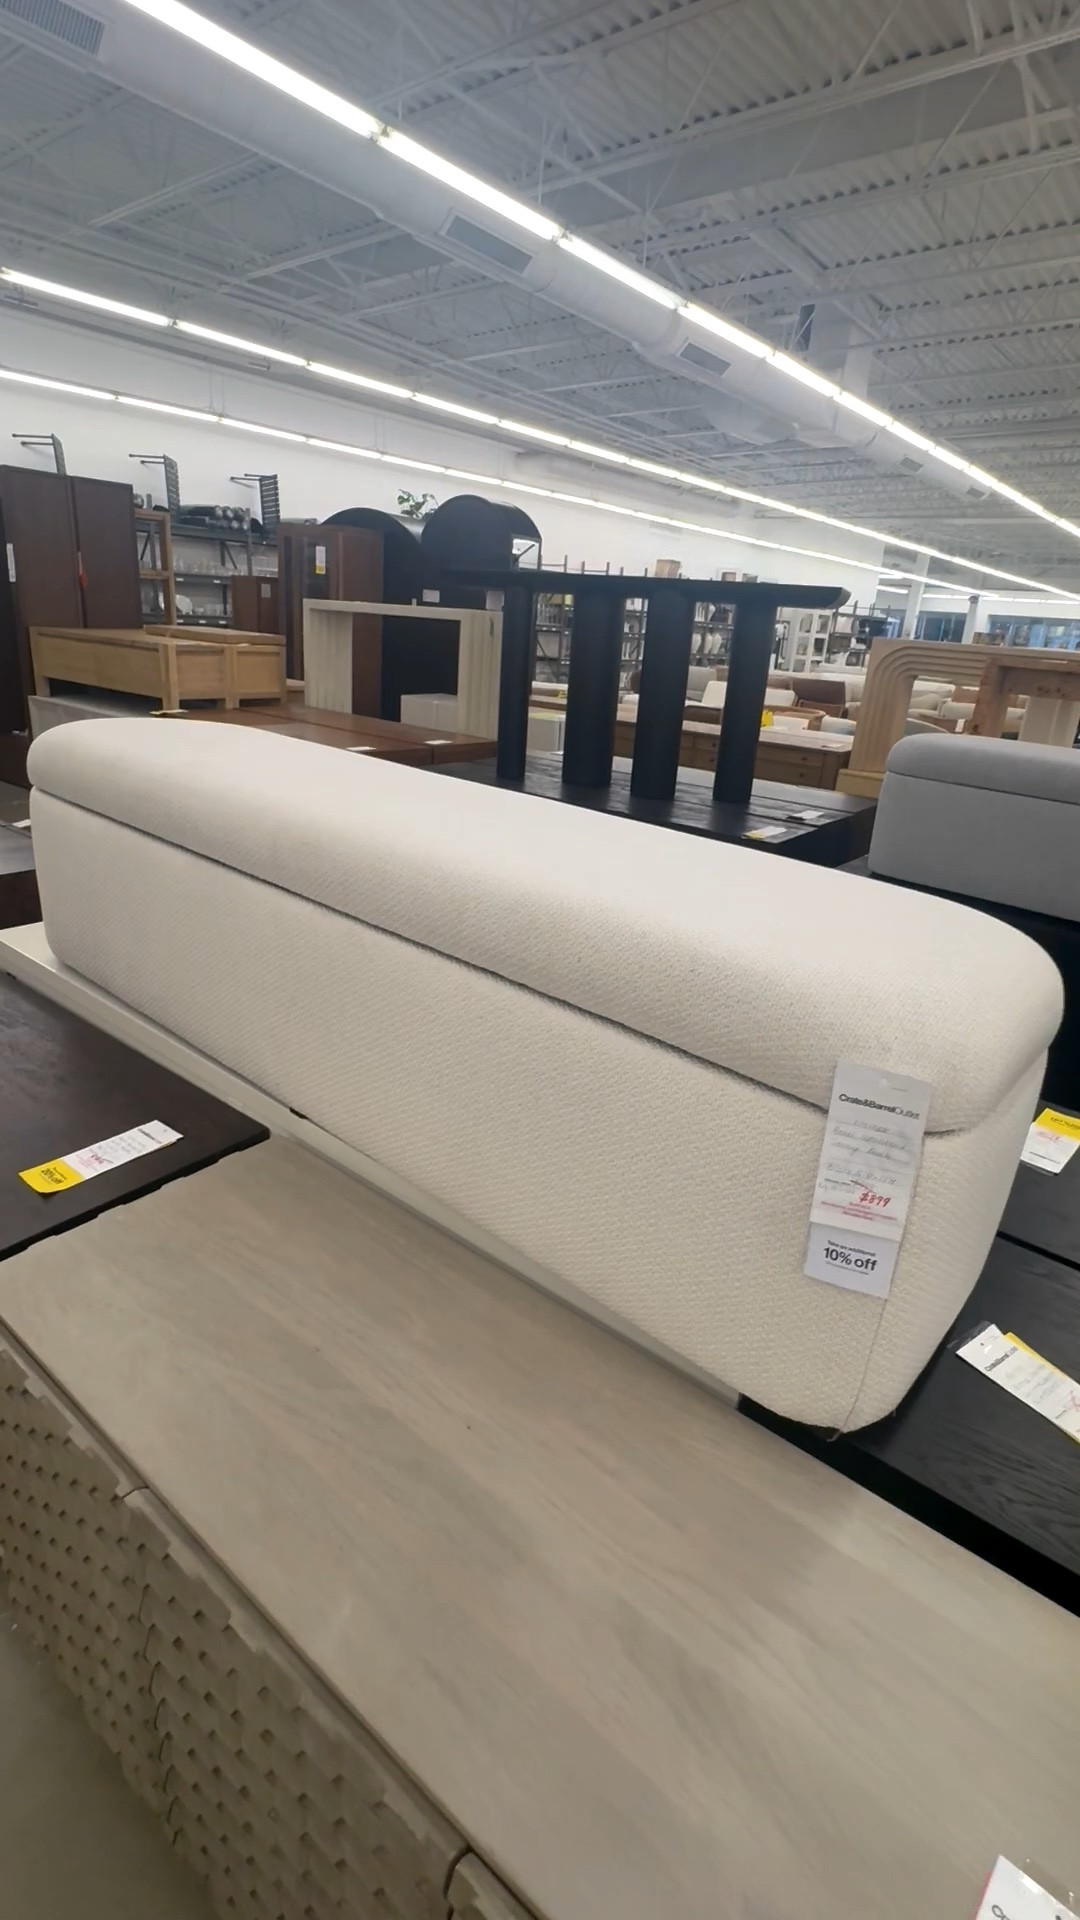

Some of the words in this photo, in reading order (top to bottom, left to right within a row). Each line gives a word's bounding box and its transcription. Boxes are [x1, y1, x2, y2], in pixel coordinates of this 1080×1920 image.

[860, 1191, 891, 1208] $899
[823, 1247, 853, 1266] 10%
[854, 1257, 877, 1272] off
